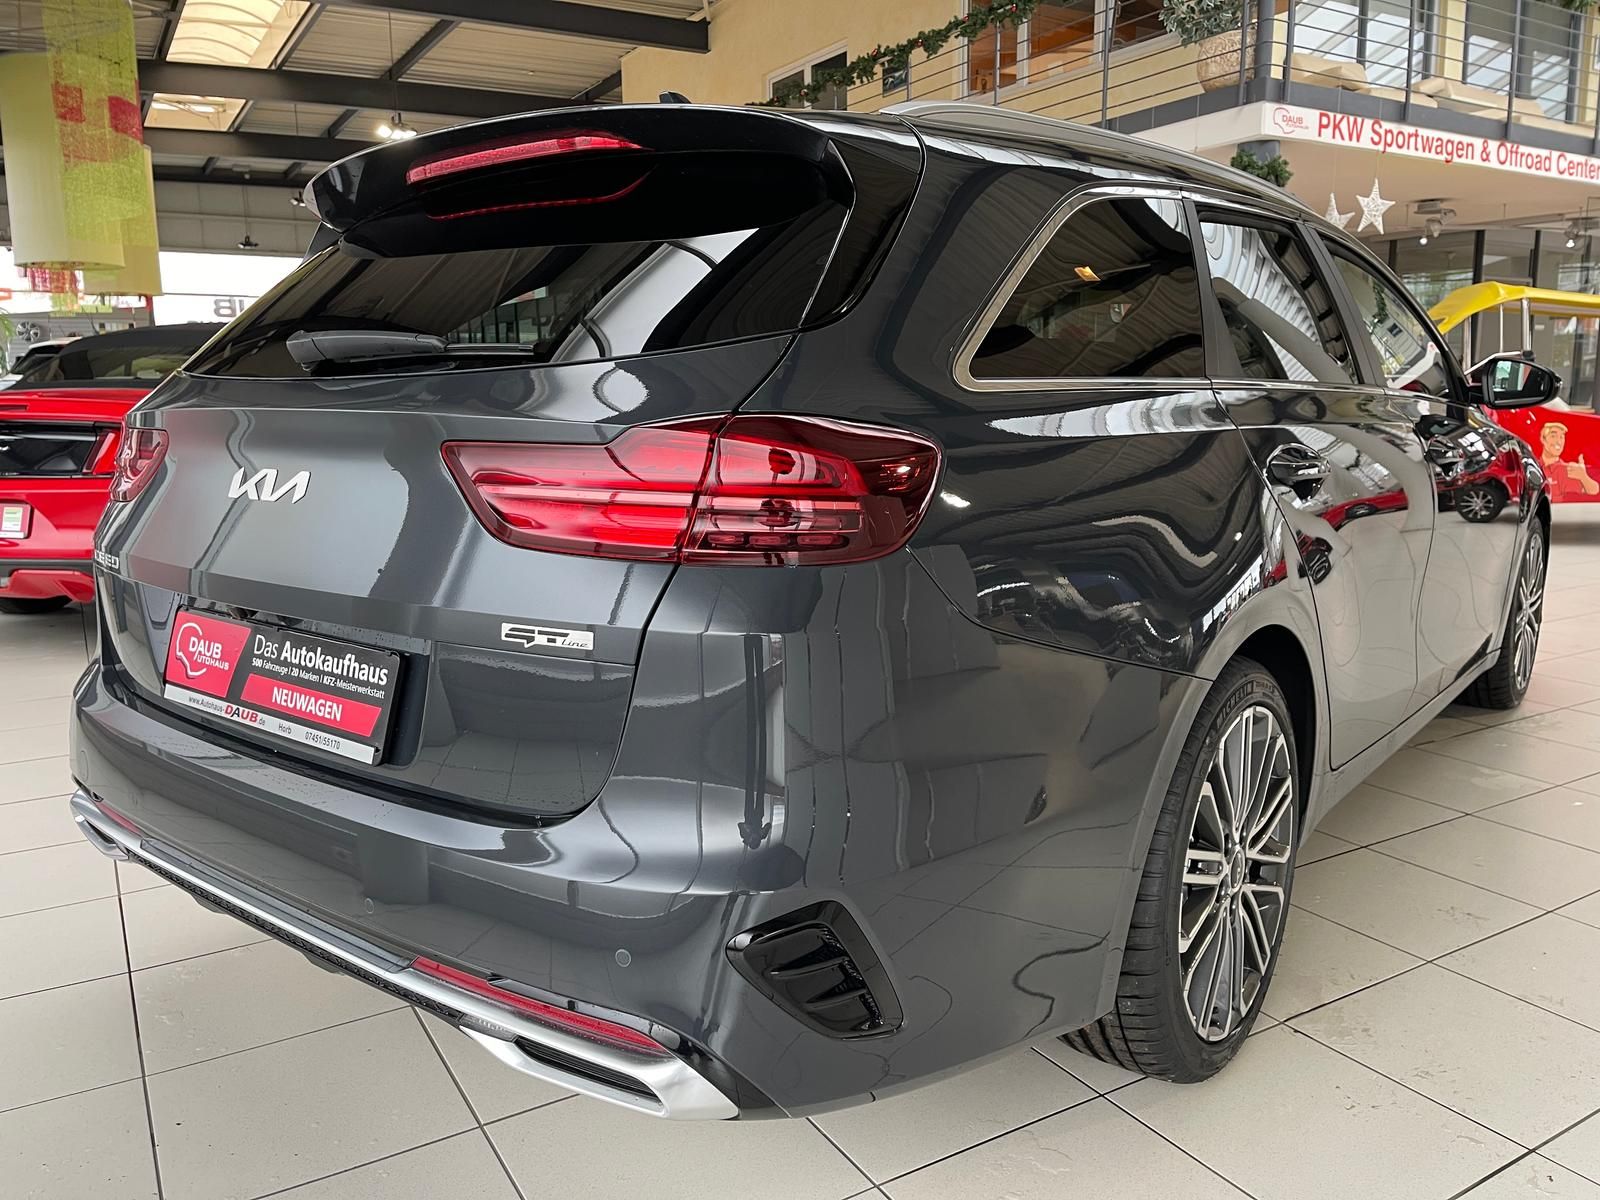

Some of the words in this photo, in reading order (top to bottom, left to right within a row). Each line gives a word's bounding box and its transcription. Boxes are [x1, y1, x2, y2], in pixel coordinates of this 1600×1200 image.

[1281, 114, 1304, 126] DAUB
[1318, 112, 1365, 143] PKW
[1370, 118, 1475, 164] Sportwagen
[1480, 138, 1491, 163] &
[1496, 141, 1553, 173] Offroad
[1556, 152, 1600, 180] Center
[228, 466, 311, 504] KIA
[189, 636, 223, 659] DAUB
[253, 634, 279, 657] Das
[280, 640, 389, 685] Autokaufhaus
[252, 657, 263, 668] 500
[263, 659, 289, 675] Fahrzeuge
[291, 667, 299, 677] 20
[299, 670, 320, 682] Marken
[322, 676, 385, 699] KFZ-Meisterwerkstatt
[271, 686, 343, 722] NEUWAGEN
[278, 722, 292, 735] Horb
[304, 731, 341, 750] 07451/55170
